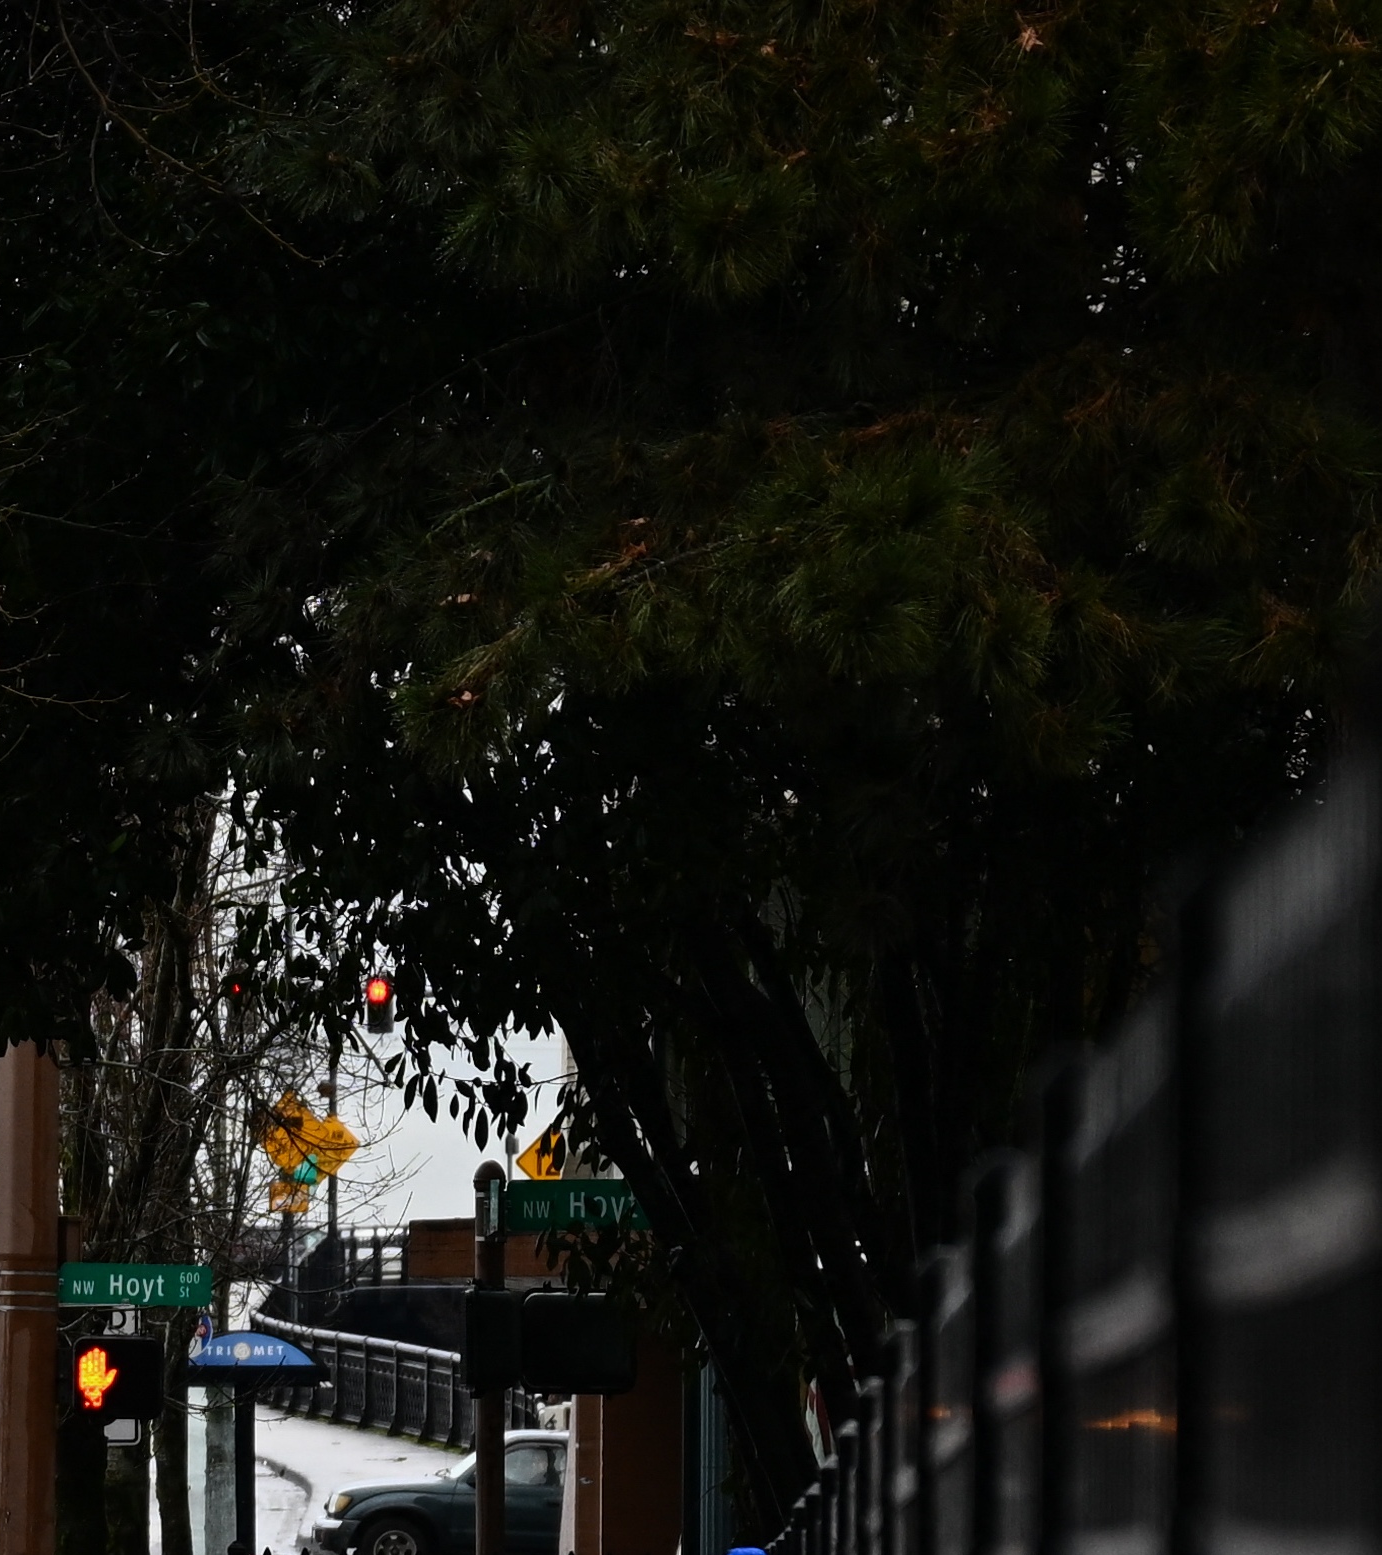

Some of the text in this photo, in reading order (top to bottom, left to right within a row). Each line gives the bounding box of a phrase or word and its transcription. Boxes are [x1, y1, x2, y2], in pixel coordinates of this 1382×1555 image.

[523, 1201, 550, 1219] NW
[179, 1272, 200, 1285] 600
[73, 1274, 165, 1303] NW Hoyt
[179, 1286, 190, 1298] St
[206, 1345, 284, 1356] TRI MET
